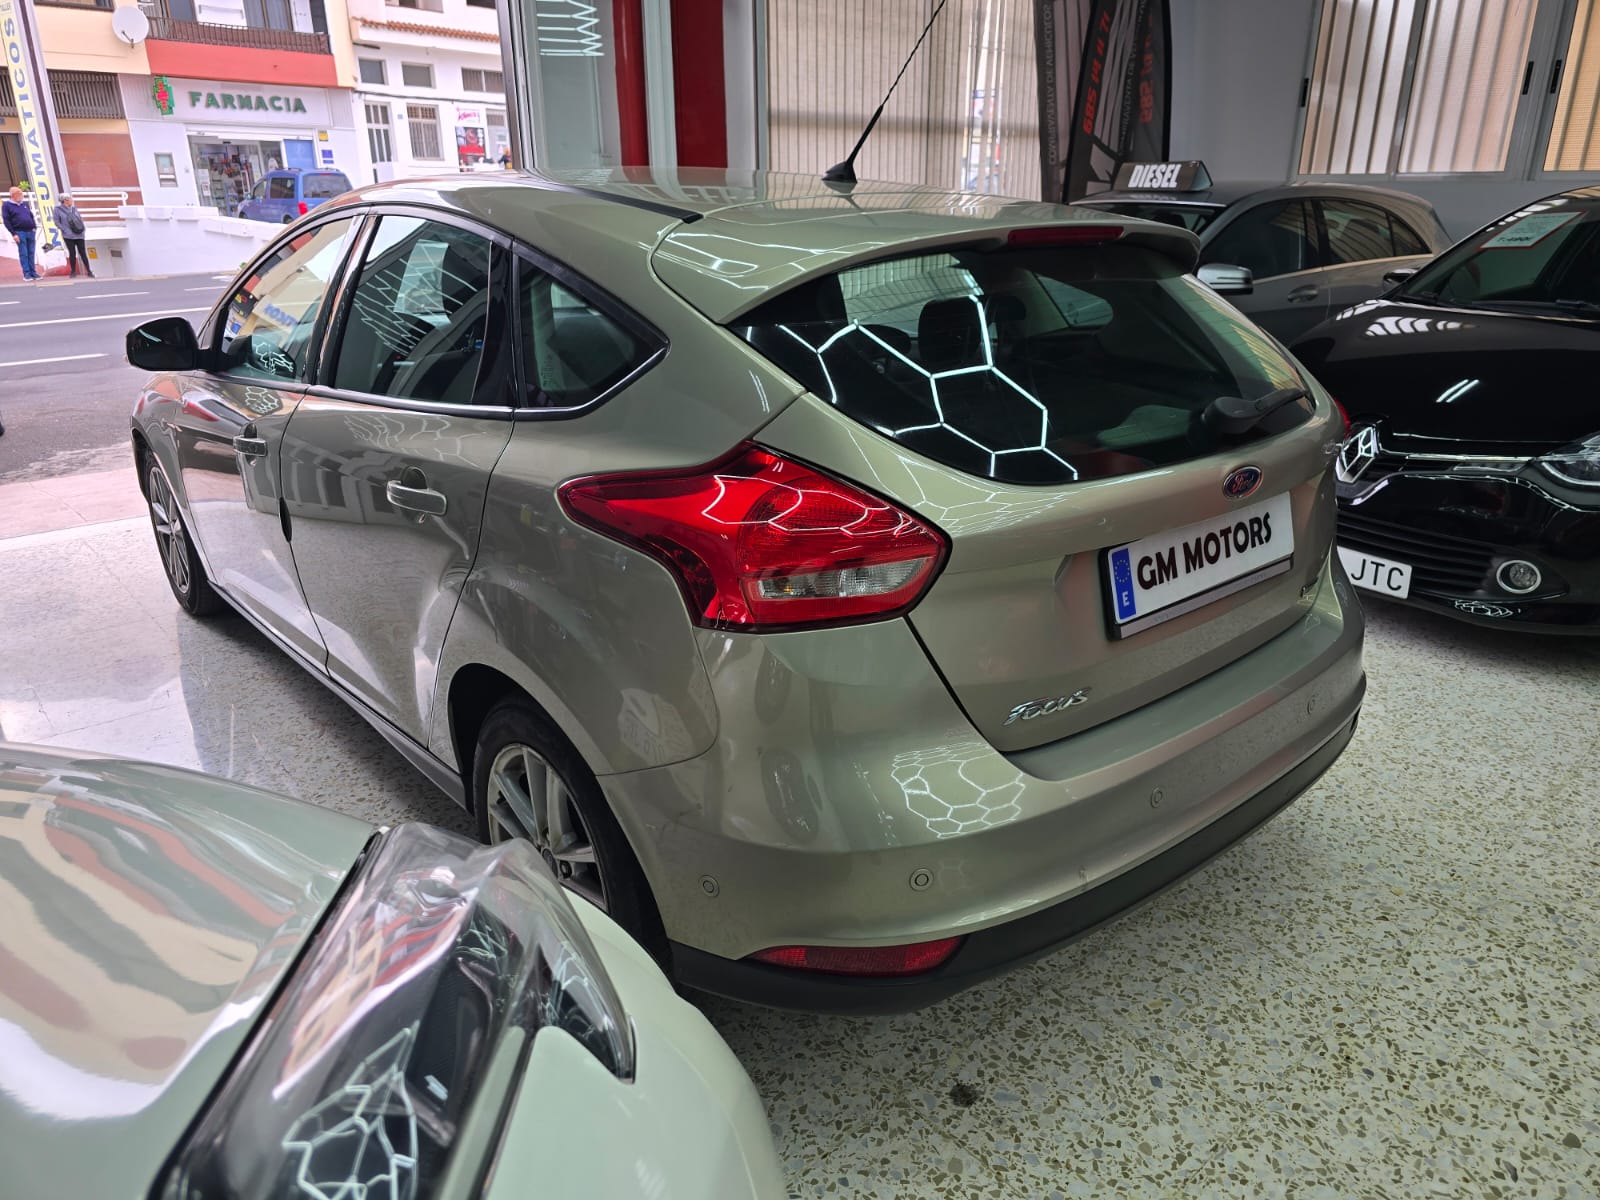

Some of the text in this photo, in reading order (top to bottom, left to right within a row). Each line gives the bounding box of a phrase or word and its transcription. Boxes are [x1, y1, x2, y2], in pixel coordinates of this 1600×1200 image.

[188, 91, 307, 113] FARMACIA
[1082, 85, 1097, 135] 685
[1128, 164, 1182, 188] DIESEL
[1137, 511, 1272, 590] GM MOTORS
[1350, 559, 1404, 591] JTC
[1122, 591, 1130, 607] E
